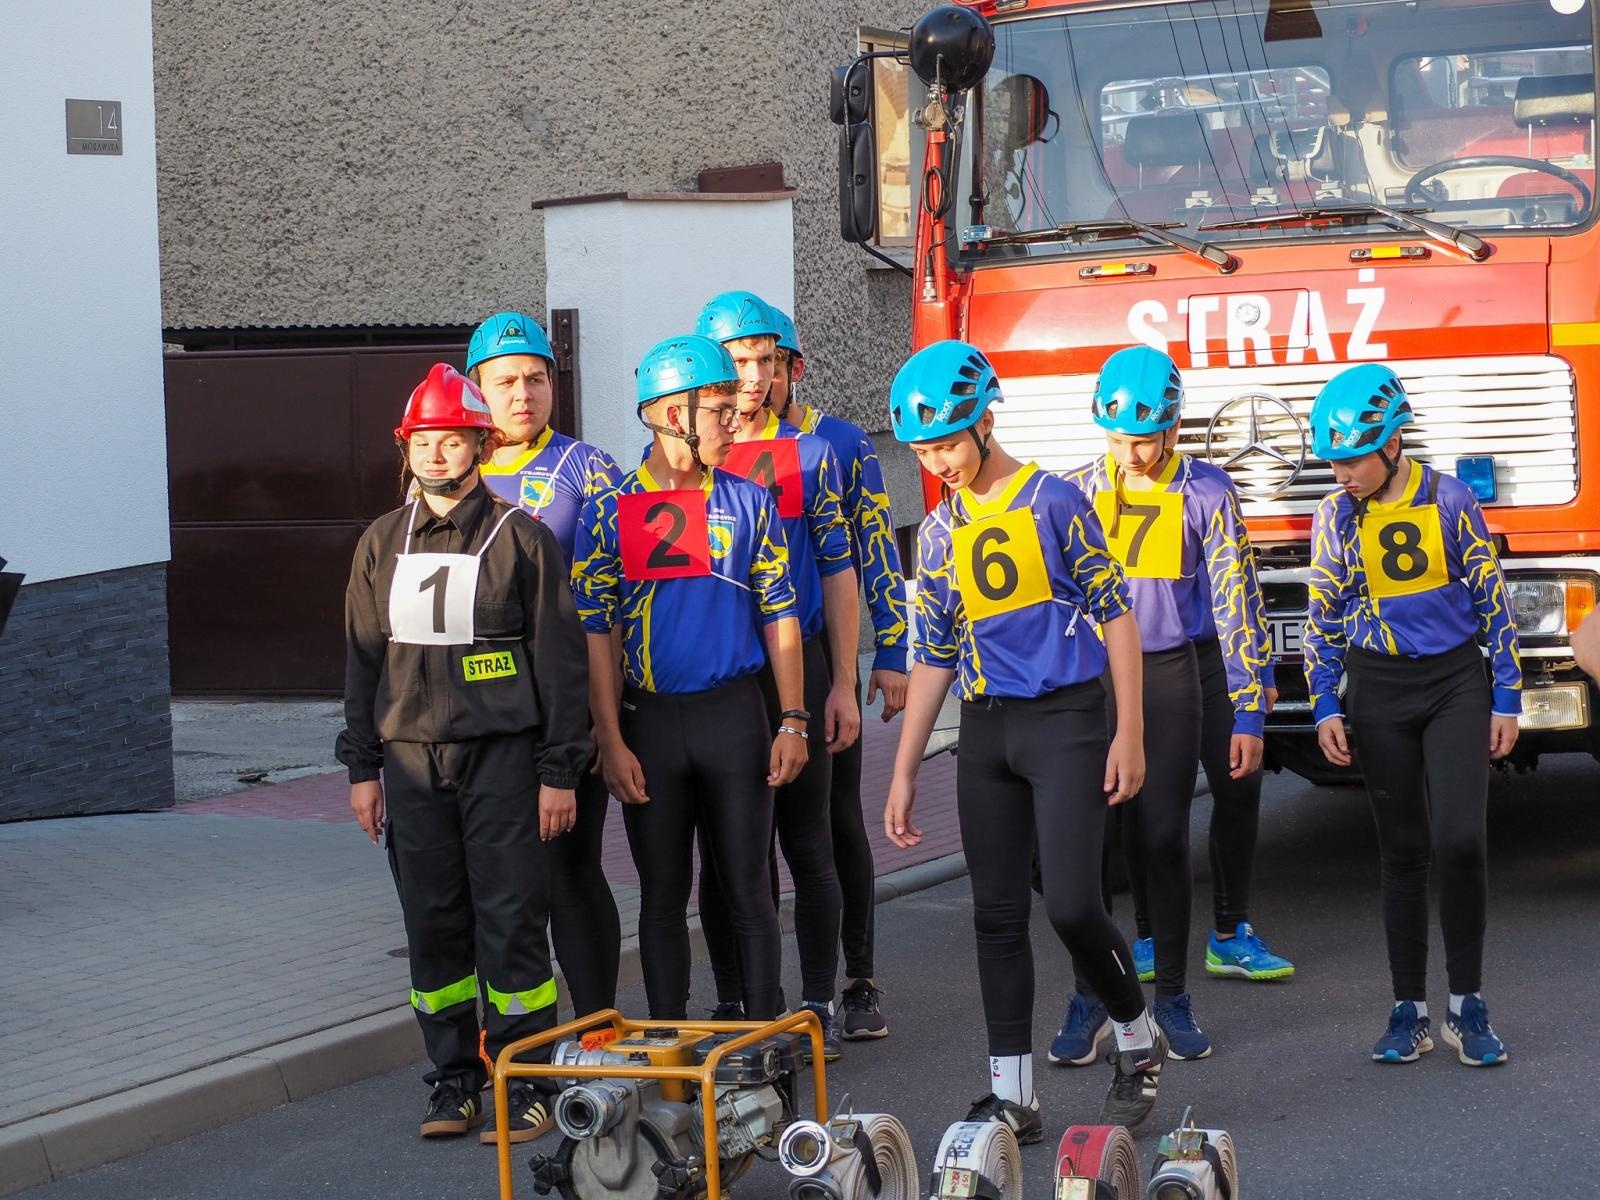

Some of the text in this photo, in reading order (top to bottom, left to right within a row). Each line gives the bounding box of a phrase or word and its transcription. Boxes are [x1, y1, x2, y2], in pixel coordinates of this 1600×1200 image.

[97, 105, 118, 136] 14
[1127, 268, 1388, 368] STRAŻ
[746, 451, 783, 508] 4
[644, 501, 690, 568] 2
[971, 526, 1018, 601] 6
[1119, 503, 1161, 567] 7
[1378, 521, 1429, 581] 8
[418, 565, 450, 634] 1
